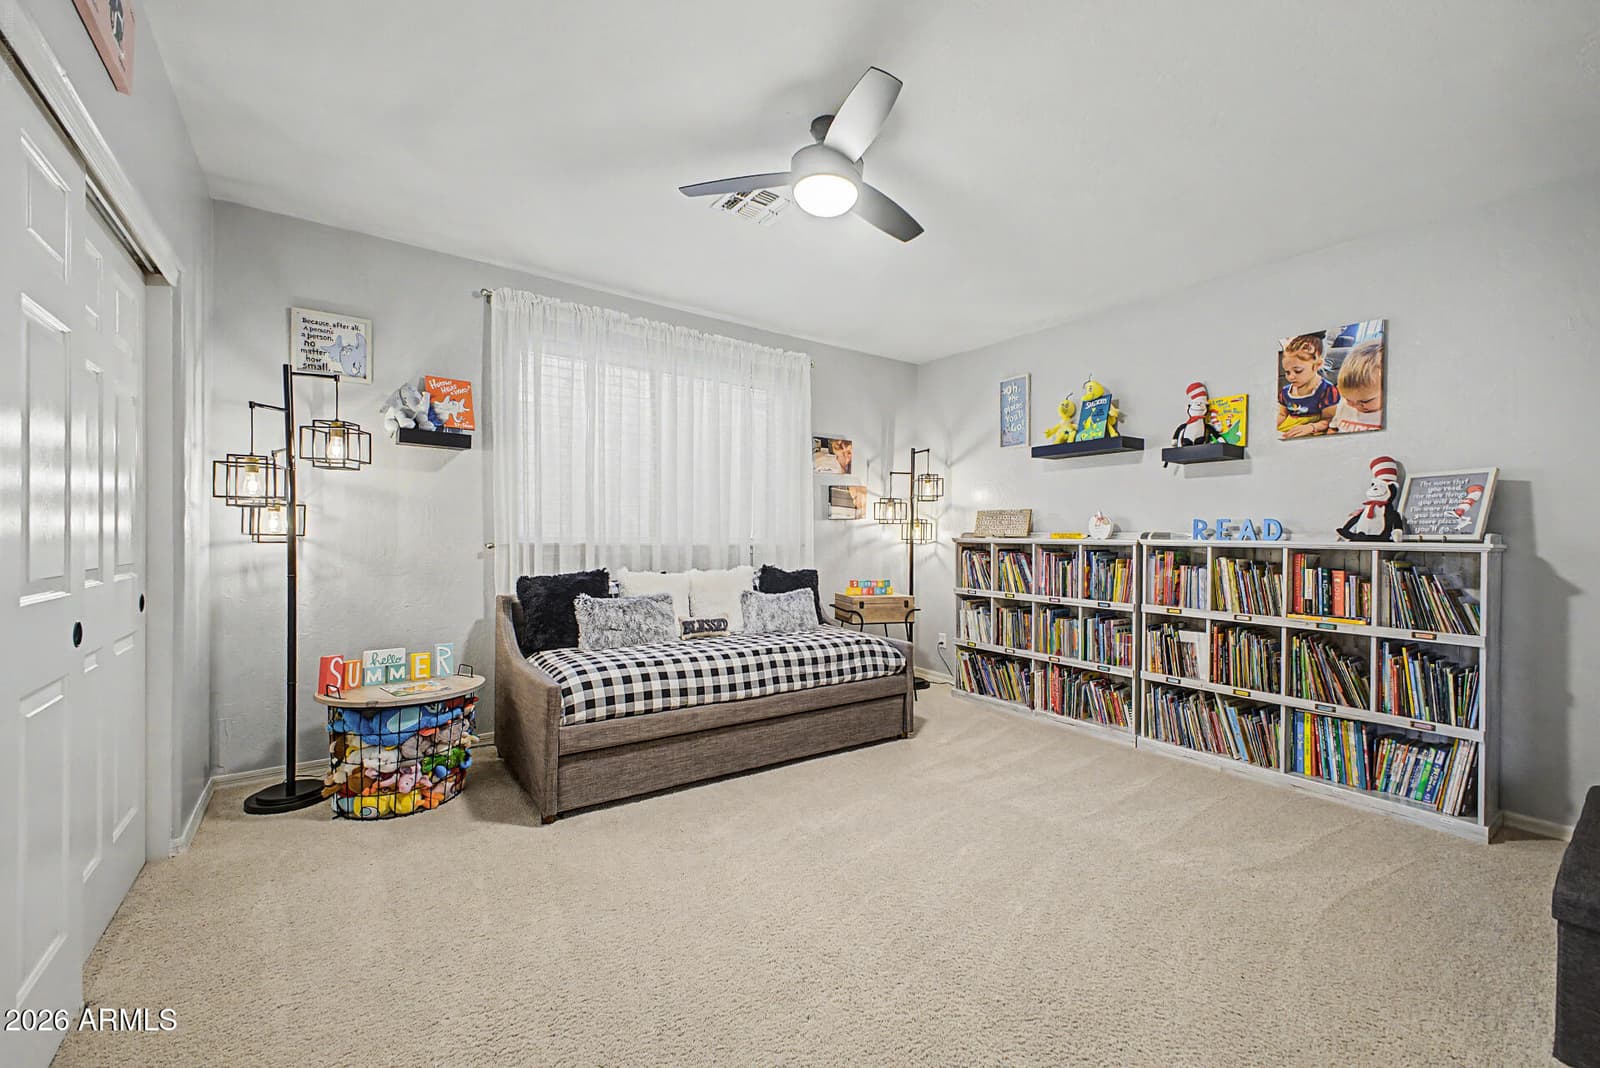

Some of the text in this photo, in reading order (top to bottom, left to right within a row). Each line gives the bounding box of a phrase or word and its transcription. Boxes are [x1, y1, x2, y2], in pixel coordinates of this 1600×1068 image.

[333, 322, 349, 330] after
[305, 354, 322, 363] how
[302, 362, 331, 372] small.
[1192, 518, 1283, 541] READ
[370, 652, 402, 666] hello
